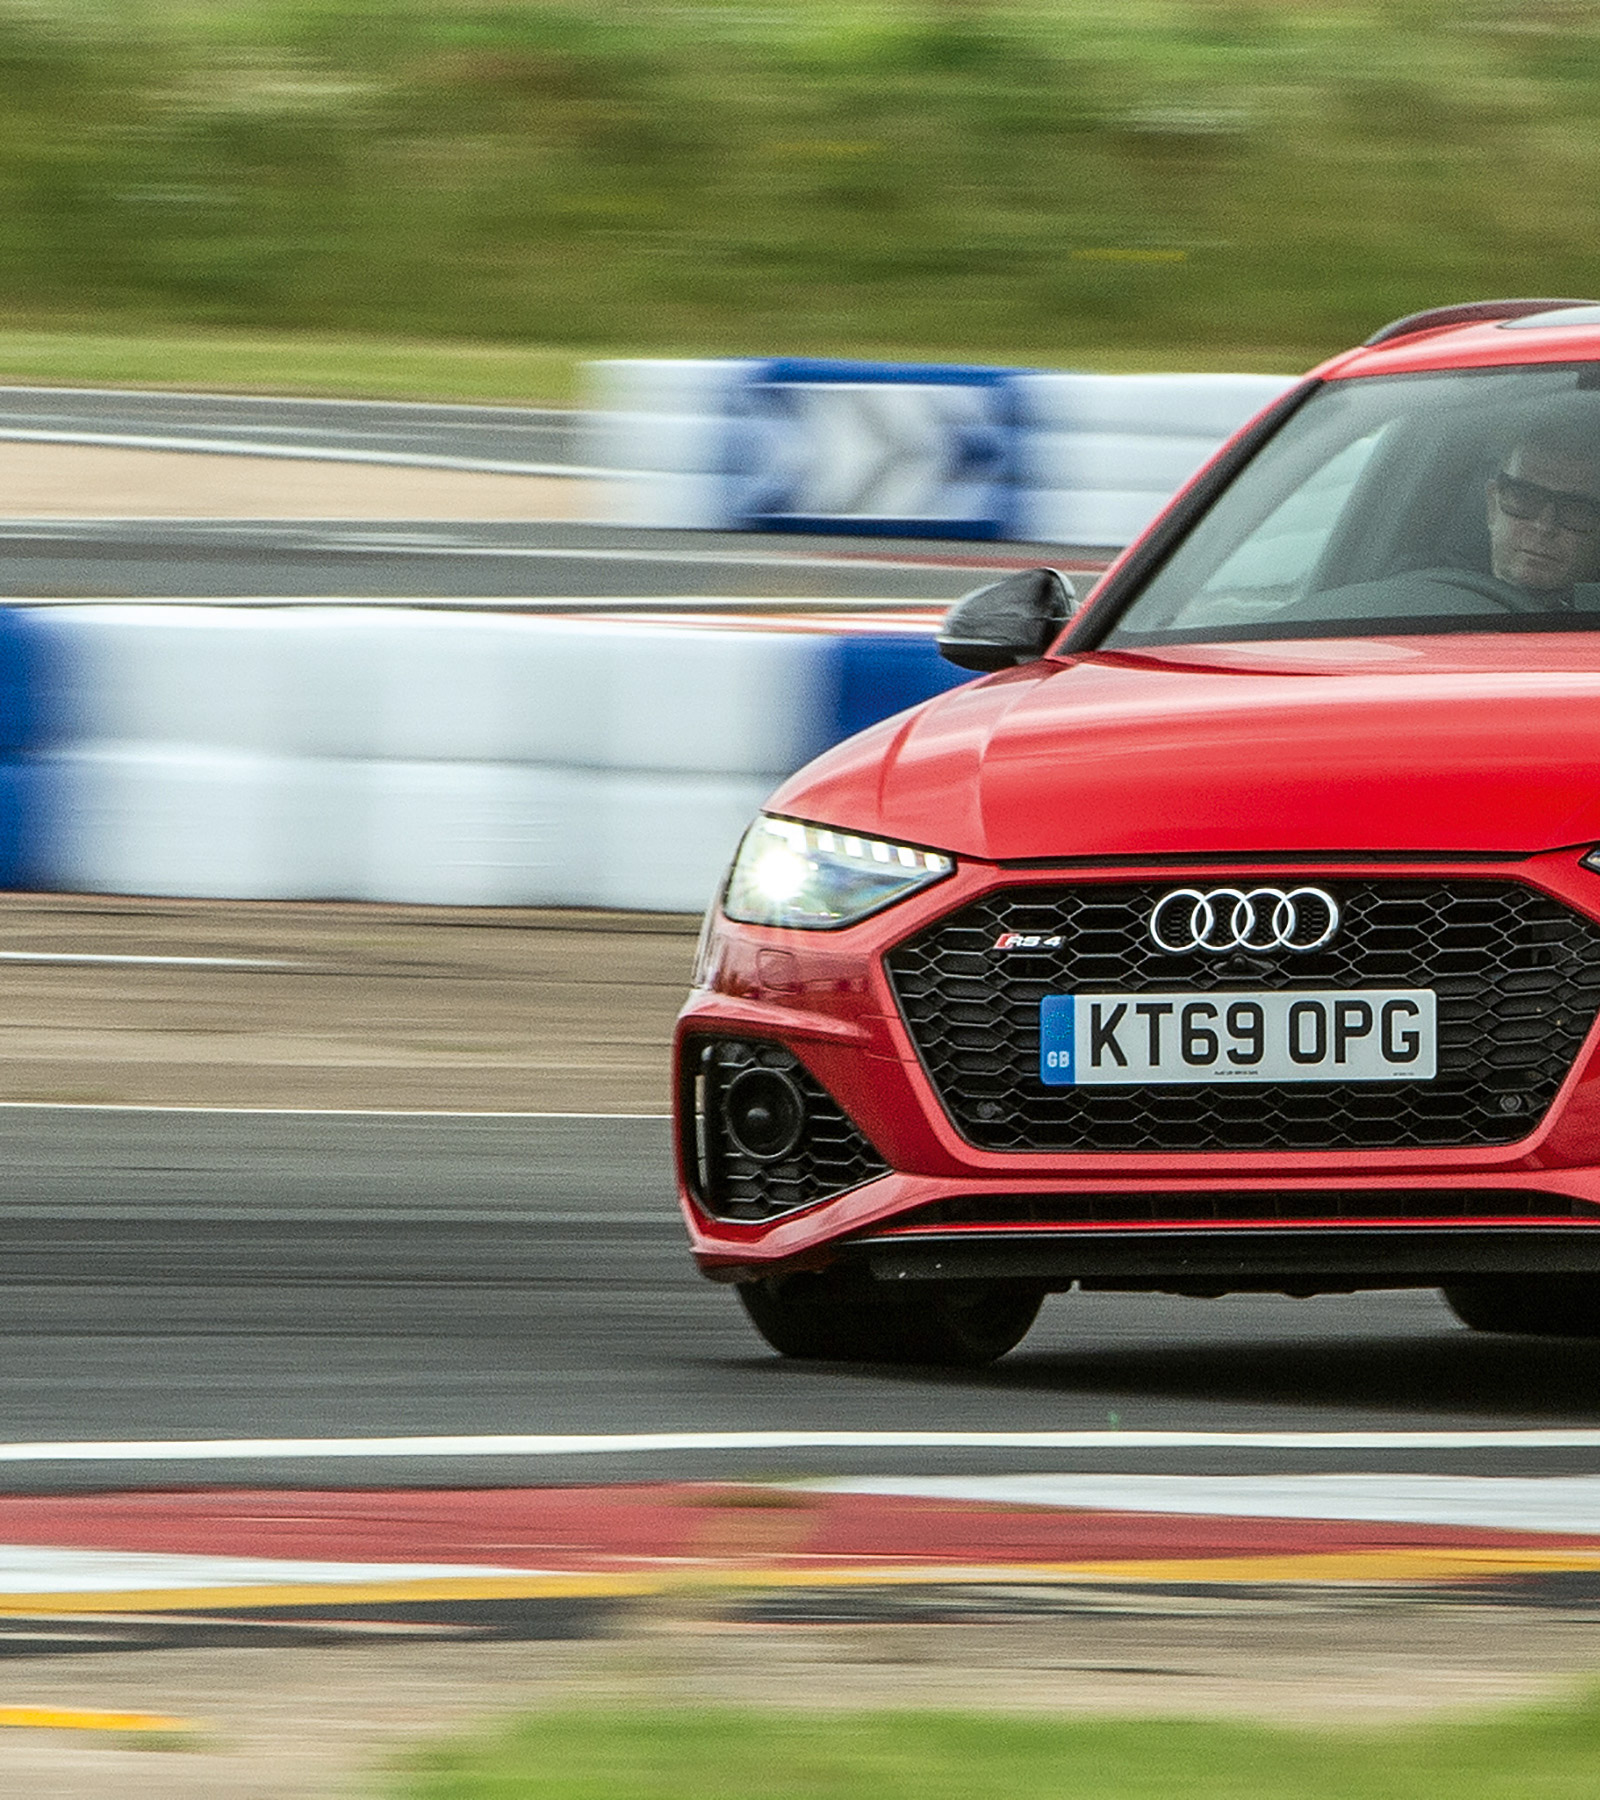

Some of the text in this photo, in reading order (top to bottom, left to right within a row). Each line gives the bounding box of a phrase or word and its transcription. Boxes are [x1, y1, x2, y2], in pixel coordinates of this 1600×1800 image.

[1090, 1000, 1420, 1067] KT69 OPG
[1047, 1051, 1070, 1068] GB
